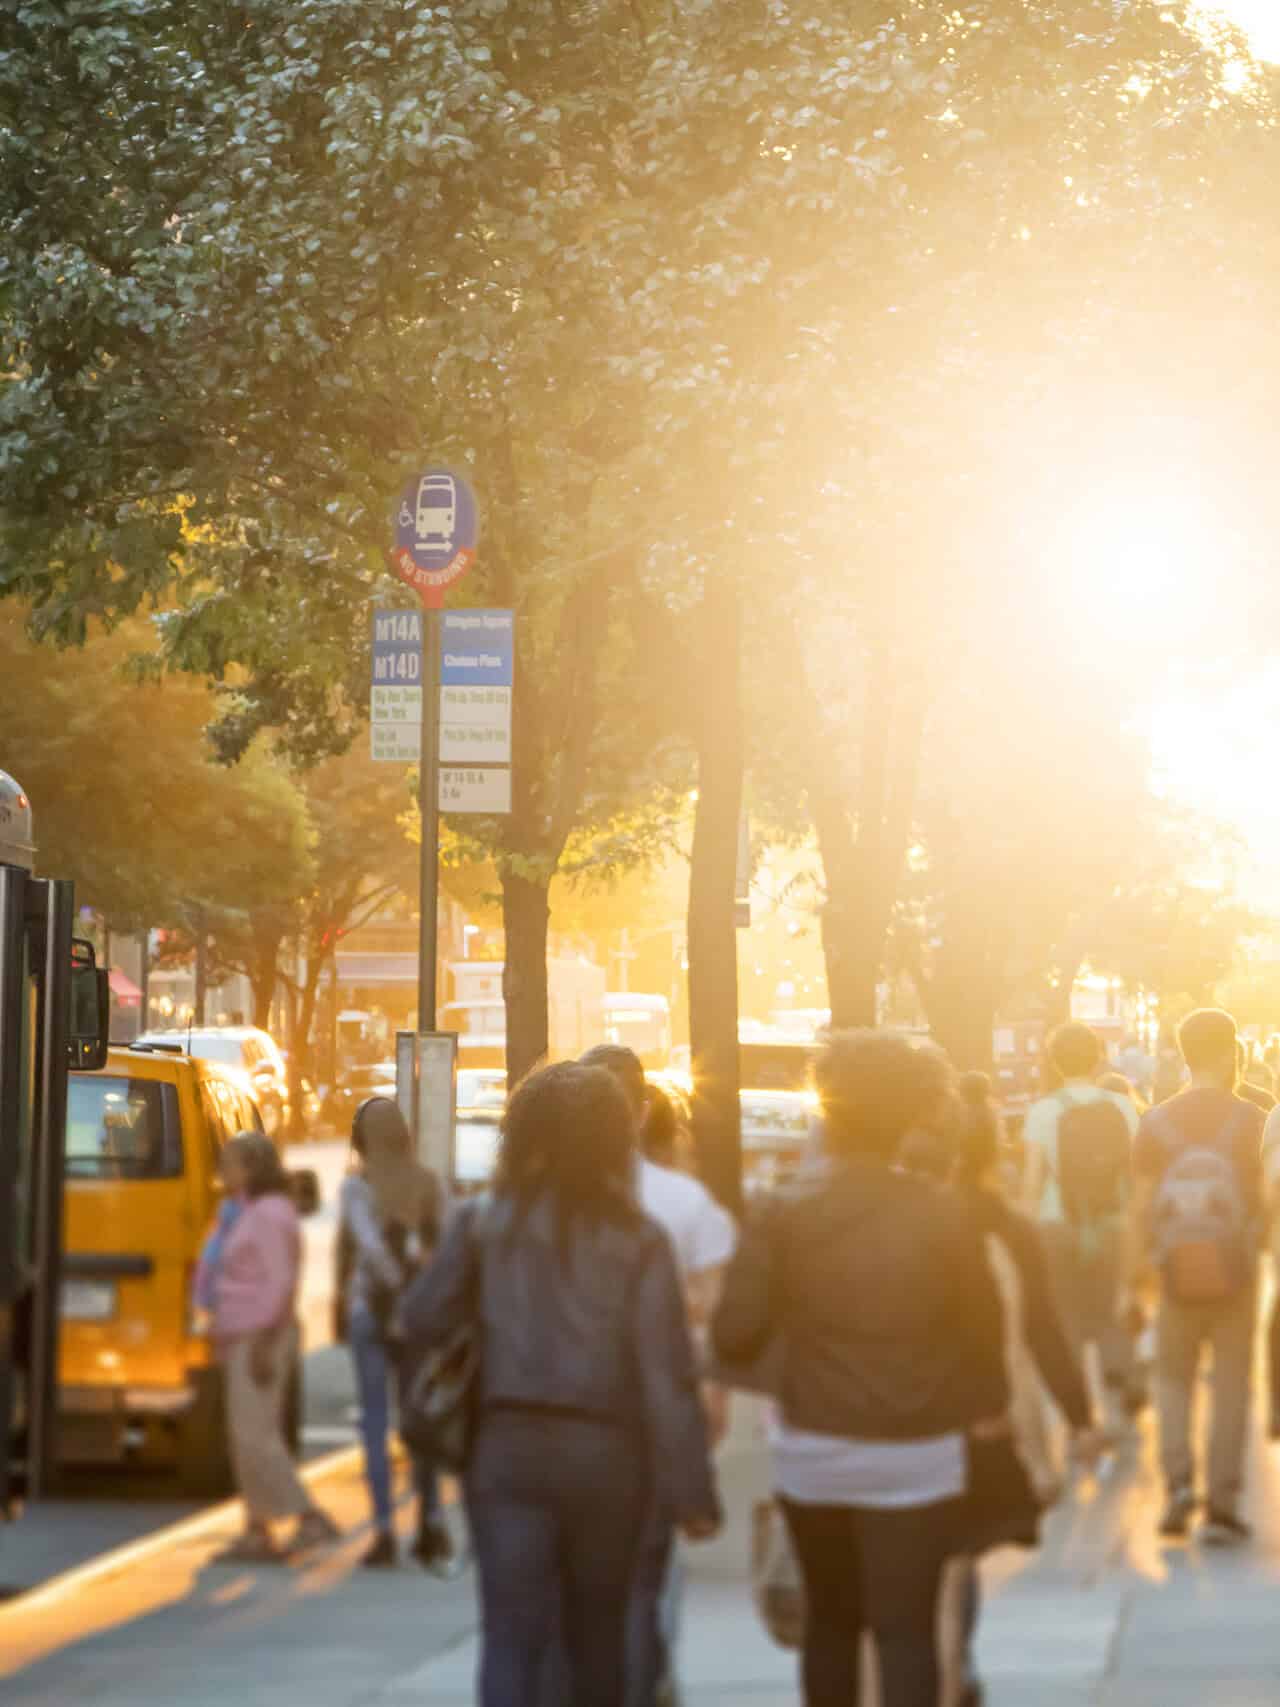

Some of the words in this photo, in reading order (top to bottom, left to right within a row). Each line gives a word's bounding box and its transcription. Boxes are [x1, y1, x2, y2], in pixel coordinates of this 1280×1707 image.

[400, 553, 415, 576] NO
[414, 552, 467, 585] STANDING
[375, 615, 420, 641] M14A
[374, 653, 419, 679] M14D
